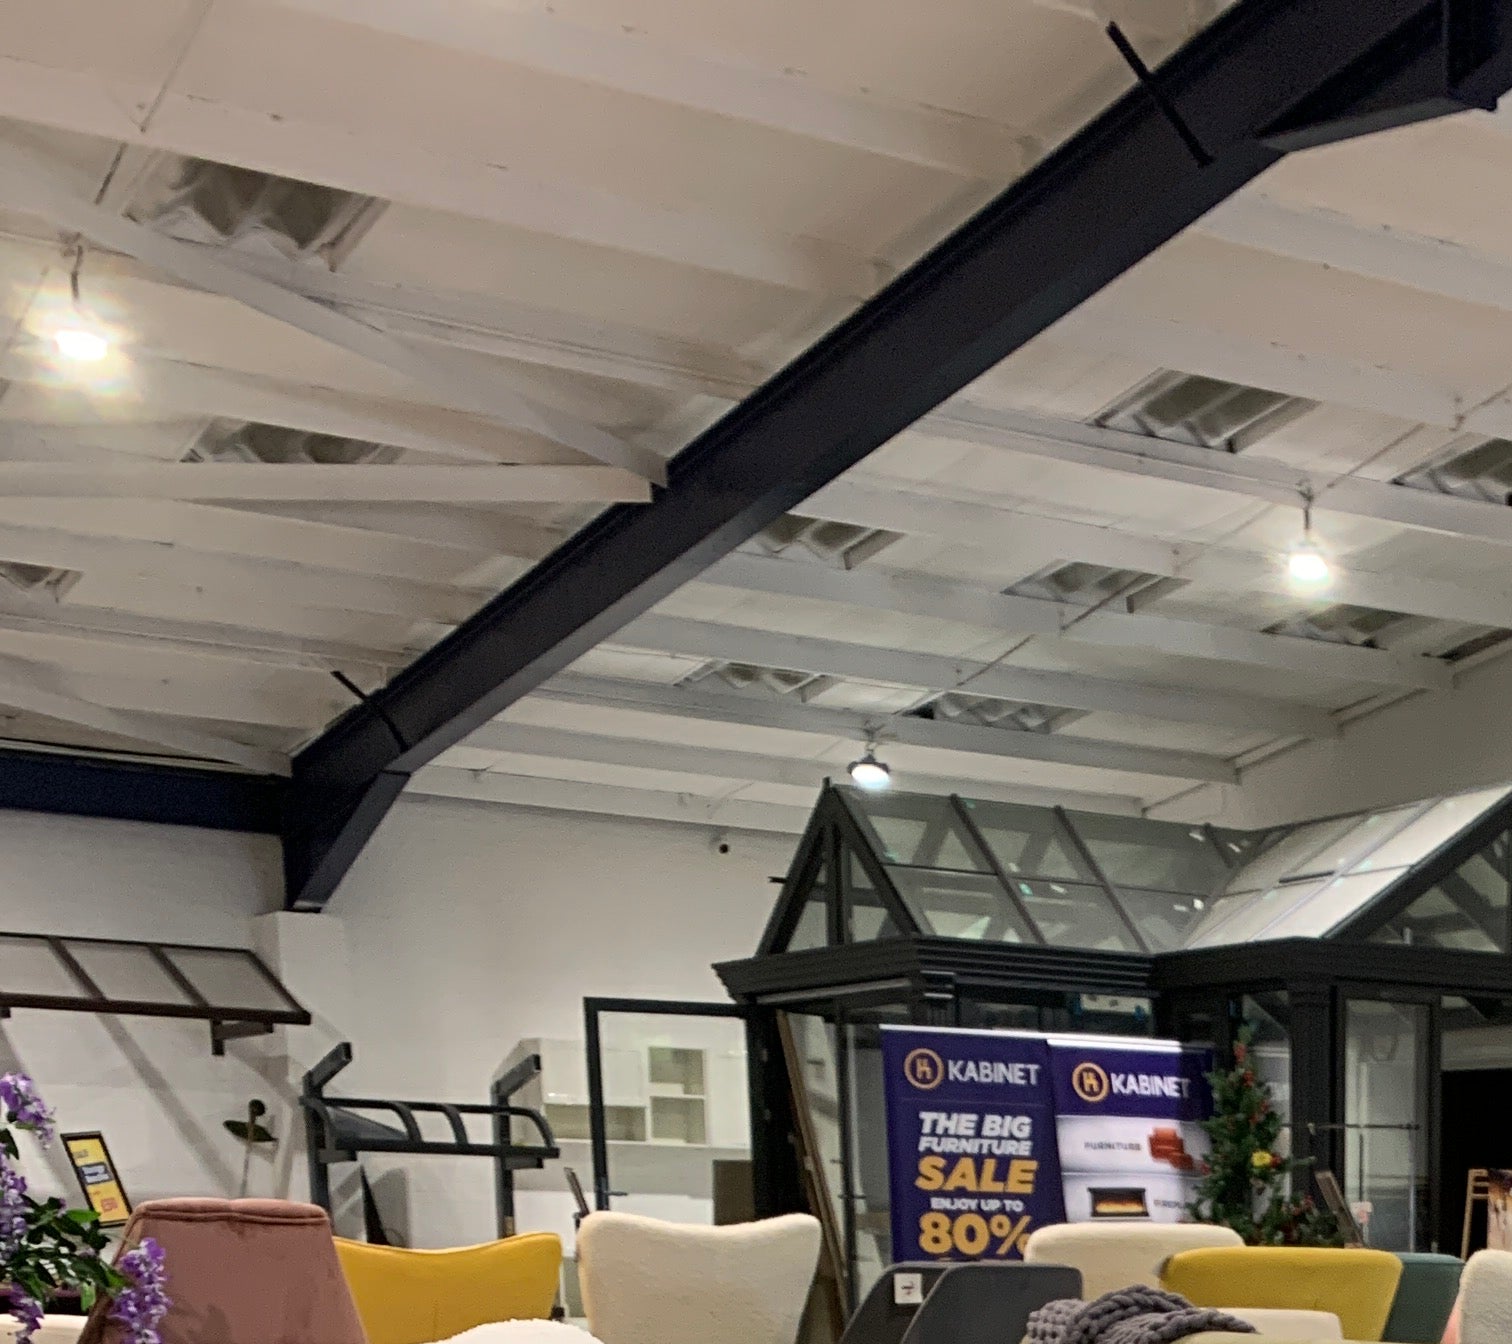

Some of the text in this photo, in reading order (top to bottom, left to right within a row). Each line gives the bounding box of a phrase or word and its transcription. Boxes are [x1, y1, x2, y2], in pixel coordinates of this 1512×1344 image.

[947, 1059, 1041, 1085] KABINET
[1110, 1072, 1191, 1098] KABINET
[918, 1111, 1032, 1138] THE BIG
[918, 1136, 1032, 1156] FURNITURE
[915, 1155, 1039, 1194] SALE
[930, 1197, 1024, 1213] ENJOY UP TO
[919, 1211, 1033, 1256] 80%
